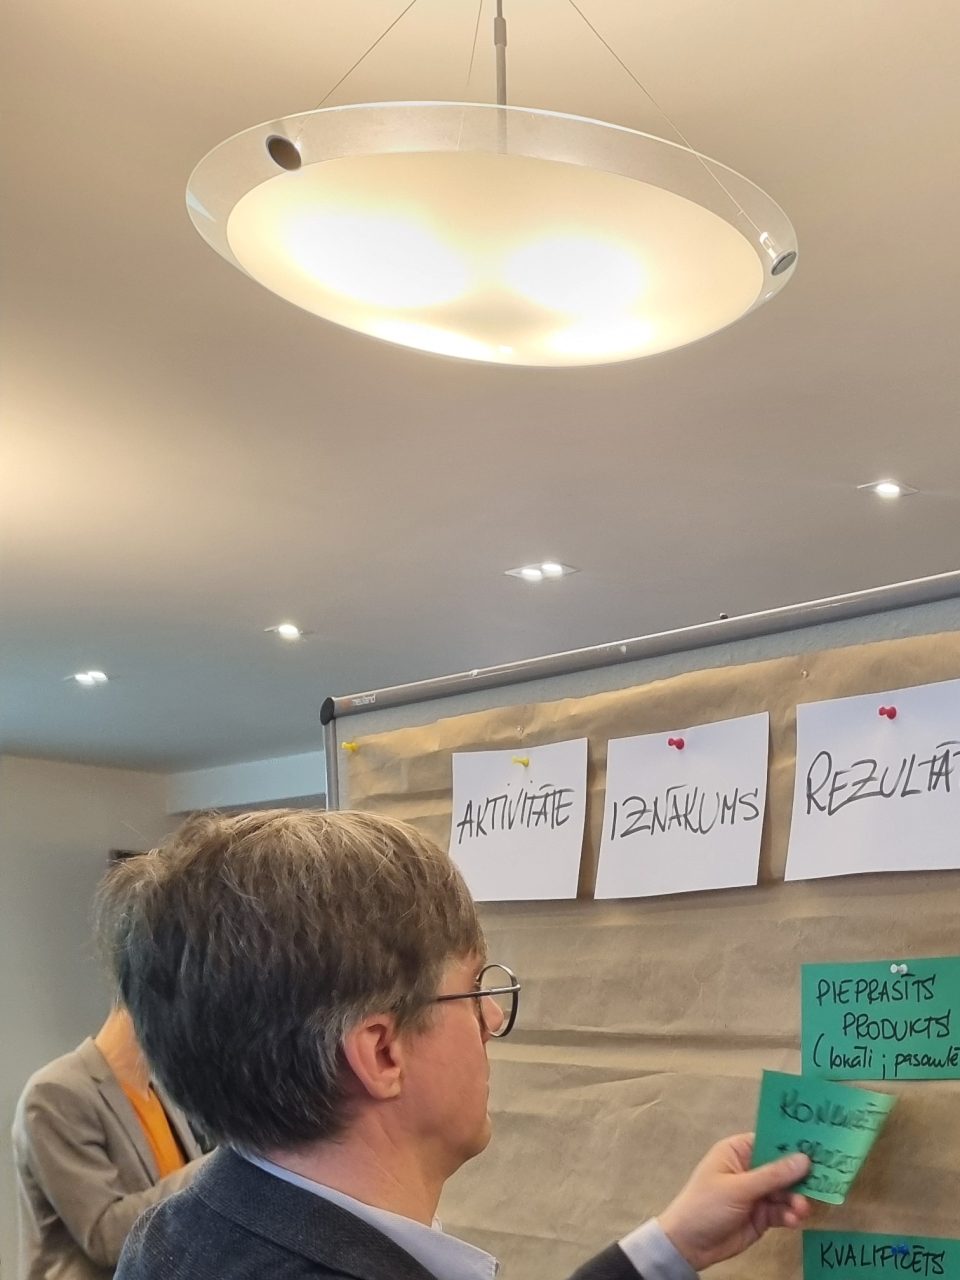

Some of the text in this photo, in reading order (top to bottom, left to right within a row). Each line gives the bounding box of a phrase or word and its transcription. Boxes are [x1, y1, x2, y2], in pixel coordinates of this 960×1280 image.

[457, 780, 575, 844] AKTIVITĀTE
[610, 784, 759, 840] IZNĀKUMS
[816, 973, 936, 1006] PIEPRASĪTS
[842, 1009, 951, 1041] PRODUKTS
